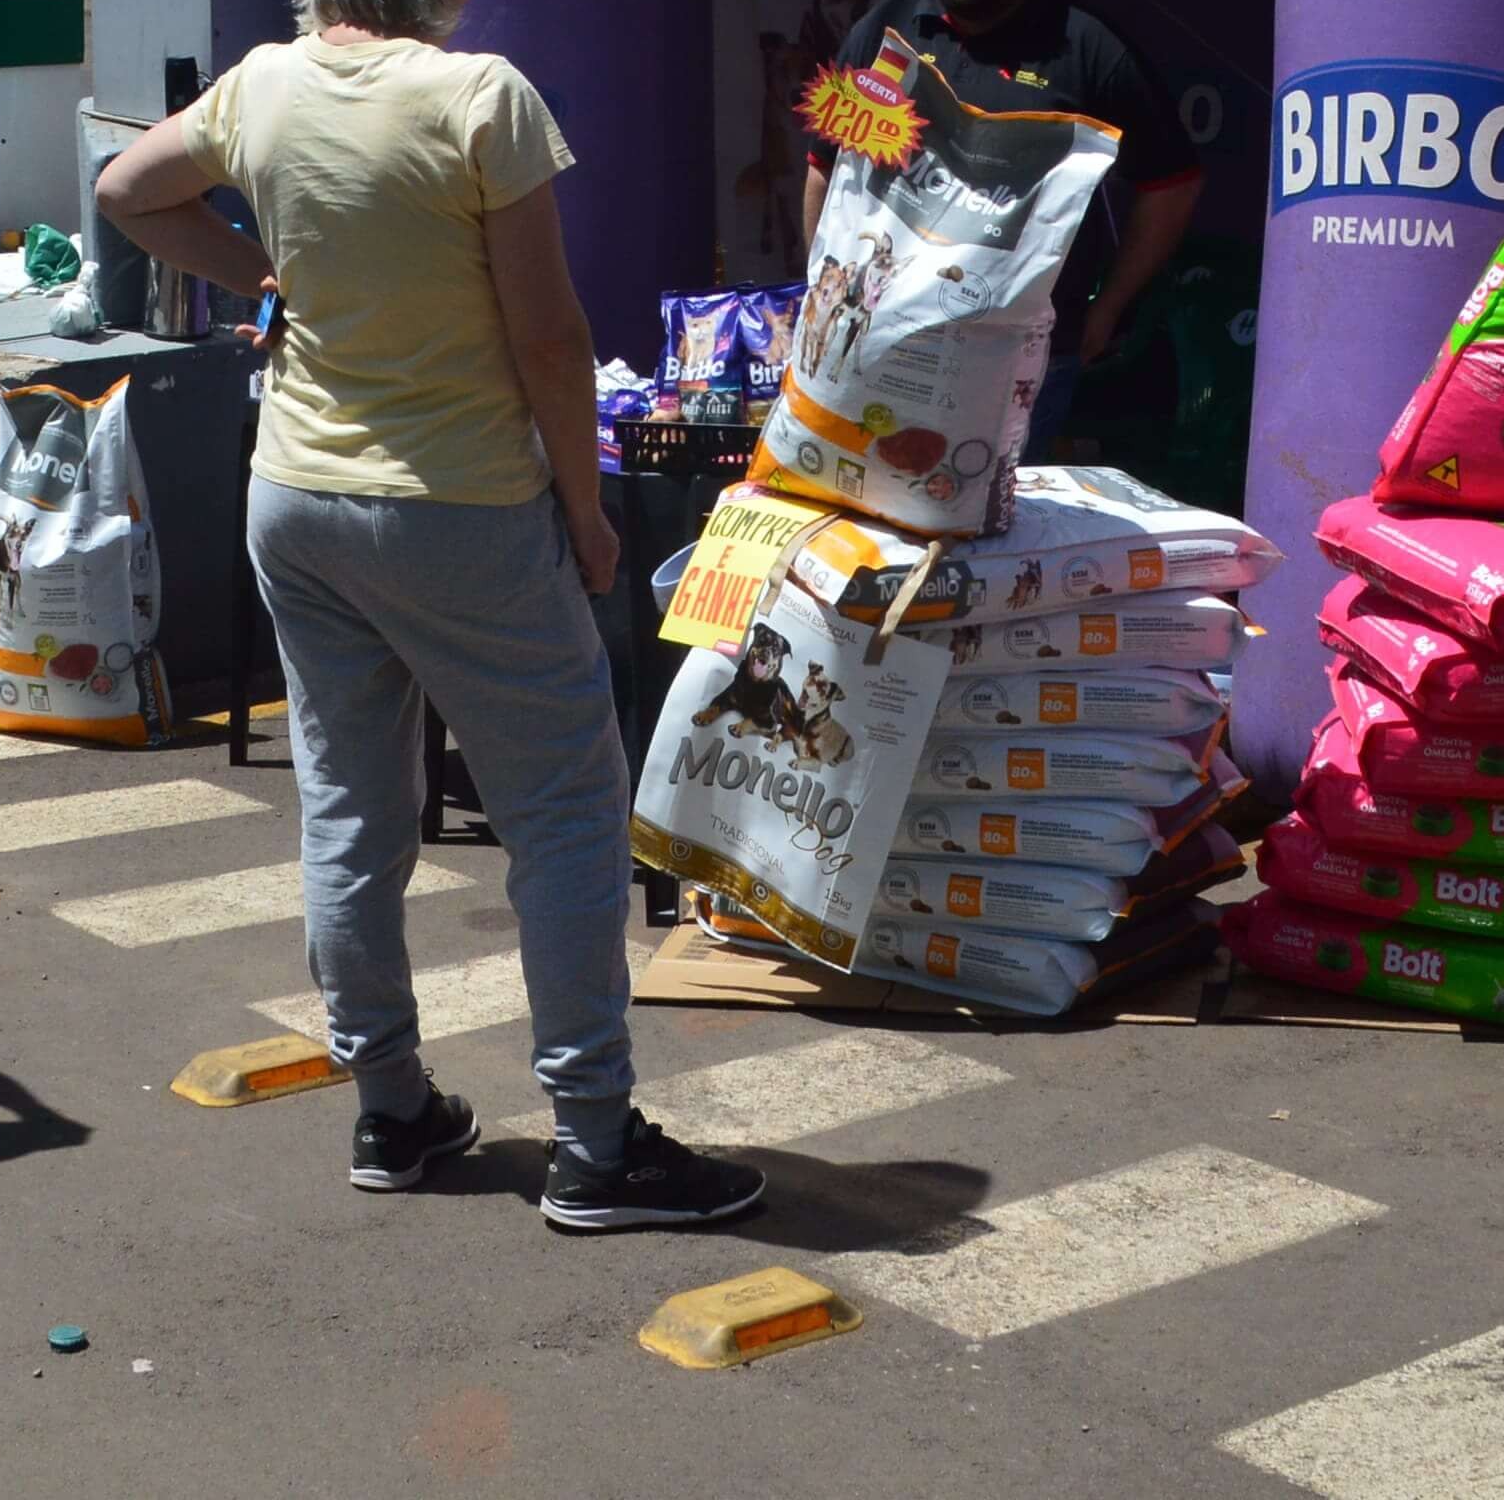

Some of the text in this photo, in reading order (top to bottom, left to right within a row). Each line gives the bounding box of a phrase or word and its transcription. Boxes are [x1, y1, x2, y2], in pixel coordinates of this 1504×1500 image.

[857, 74, 898, 104] OFERTA
[984, 223, 1002, 237] GO
[1311, 216, 1455, 250] PREMIUM
[708, 504, 804, 548] COMPRE
[717, 545, 735, 569] E
[673, 566, 762, 630] GANHE
[880, 575, 960, 600] Mello
[669, 736, 854, 839] Monello
[791, 820, 853, 875] Dog
[1436, 872, 1500, 908] Bolt
[1384, 944, 1443, 982] Bolt
